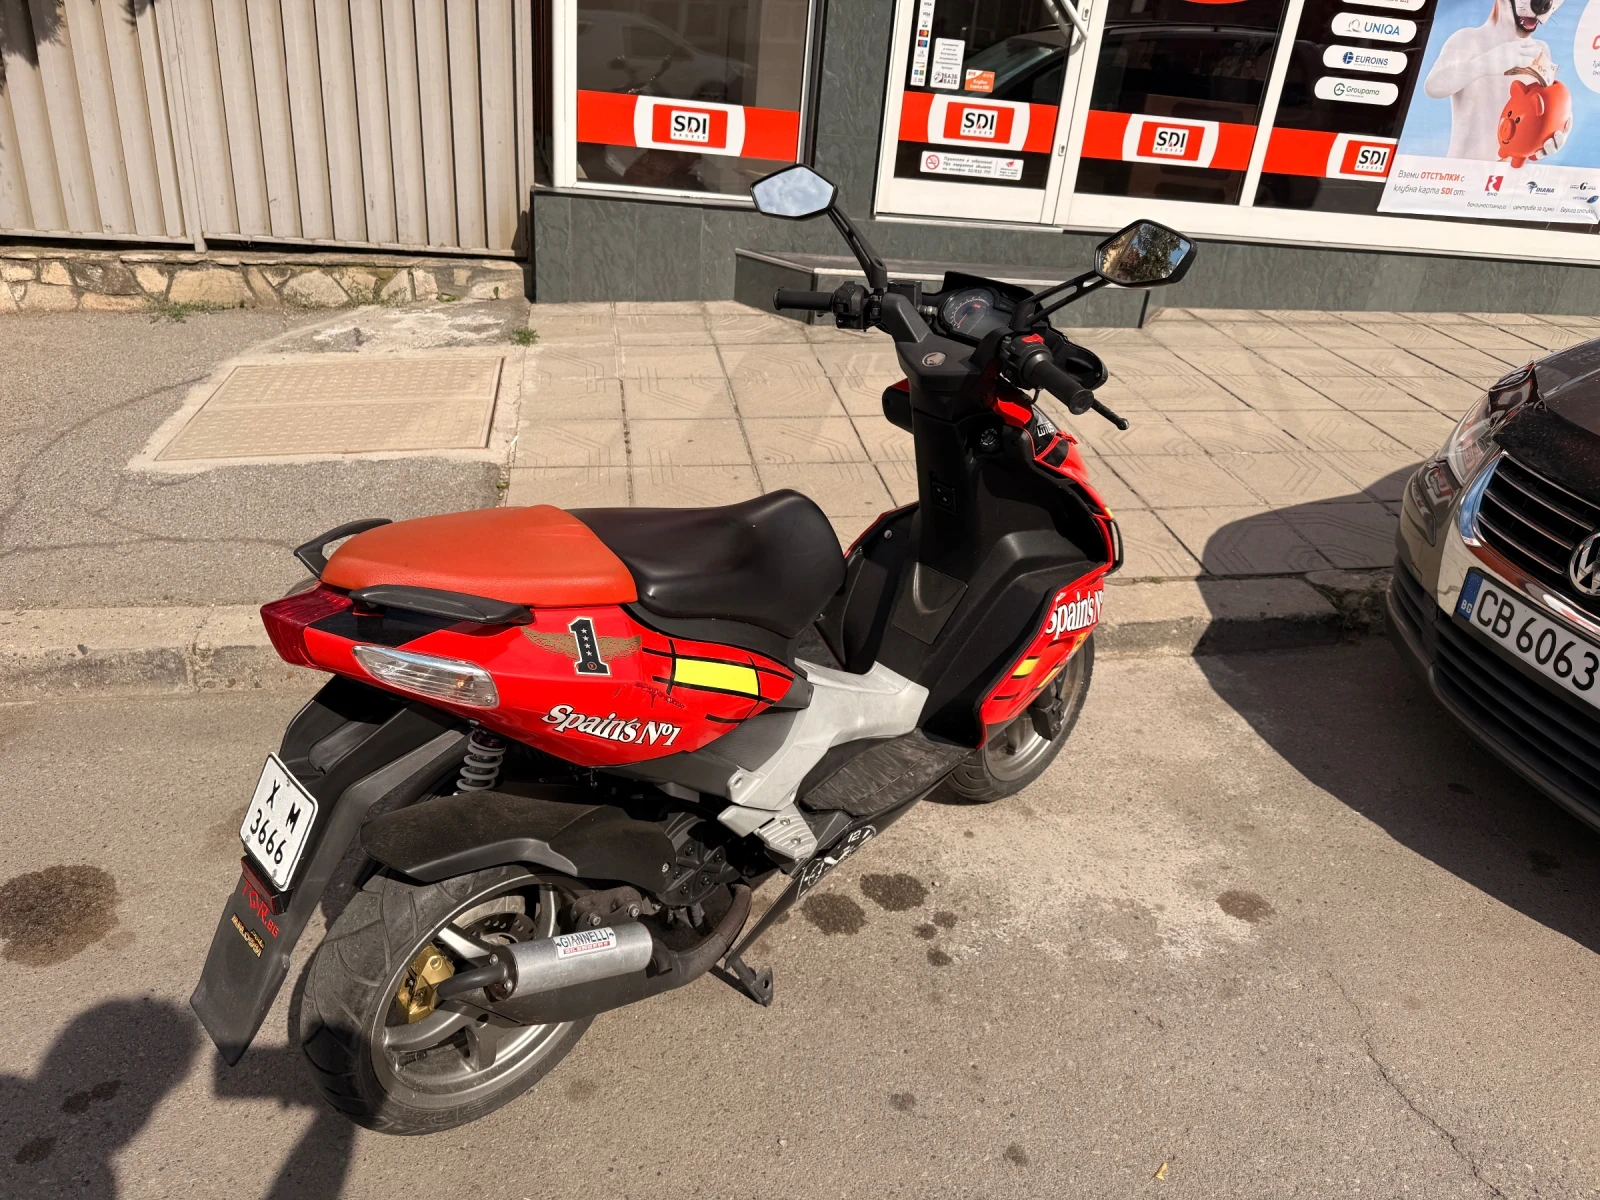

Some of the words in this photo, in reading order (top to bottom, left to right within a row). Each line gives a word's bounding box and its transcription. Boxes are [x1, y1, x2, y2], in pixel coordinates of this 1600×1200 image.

[1364, 22, 1400, 36] UNIQA
[1355, 55, 1388, 66] EUROINS
[1346, 86, 1380, 96] Groupama
[673, 115, 707, 135] SDI
[963, 112, 995, 130] SDI
[1156, 131, 1187, 148] SDI
[1358, 149, 1388, 166] SDI
[1397, 169, 1420, 179] Вземи
[1420, 171, 1460, 182] ОТСТЪПКИ
[1393, 184, 1418, 194] клубна
[1418, 185, 1440, 195] карта
[1440, 187, 1454, 195] SDI
[1036, 422, 1055, 437] LOTUS
[1460, 599, 1473, 614] BG
[266, 779, 280, 810] X
[285, 801, 301, 834] M
[249, 808, 287, 865] 3666
[559, 929, 611, 948] GIANNELLI
